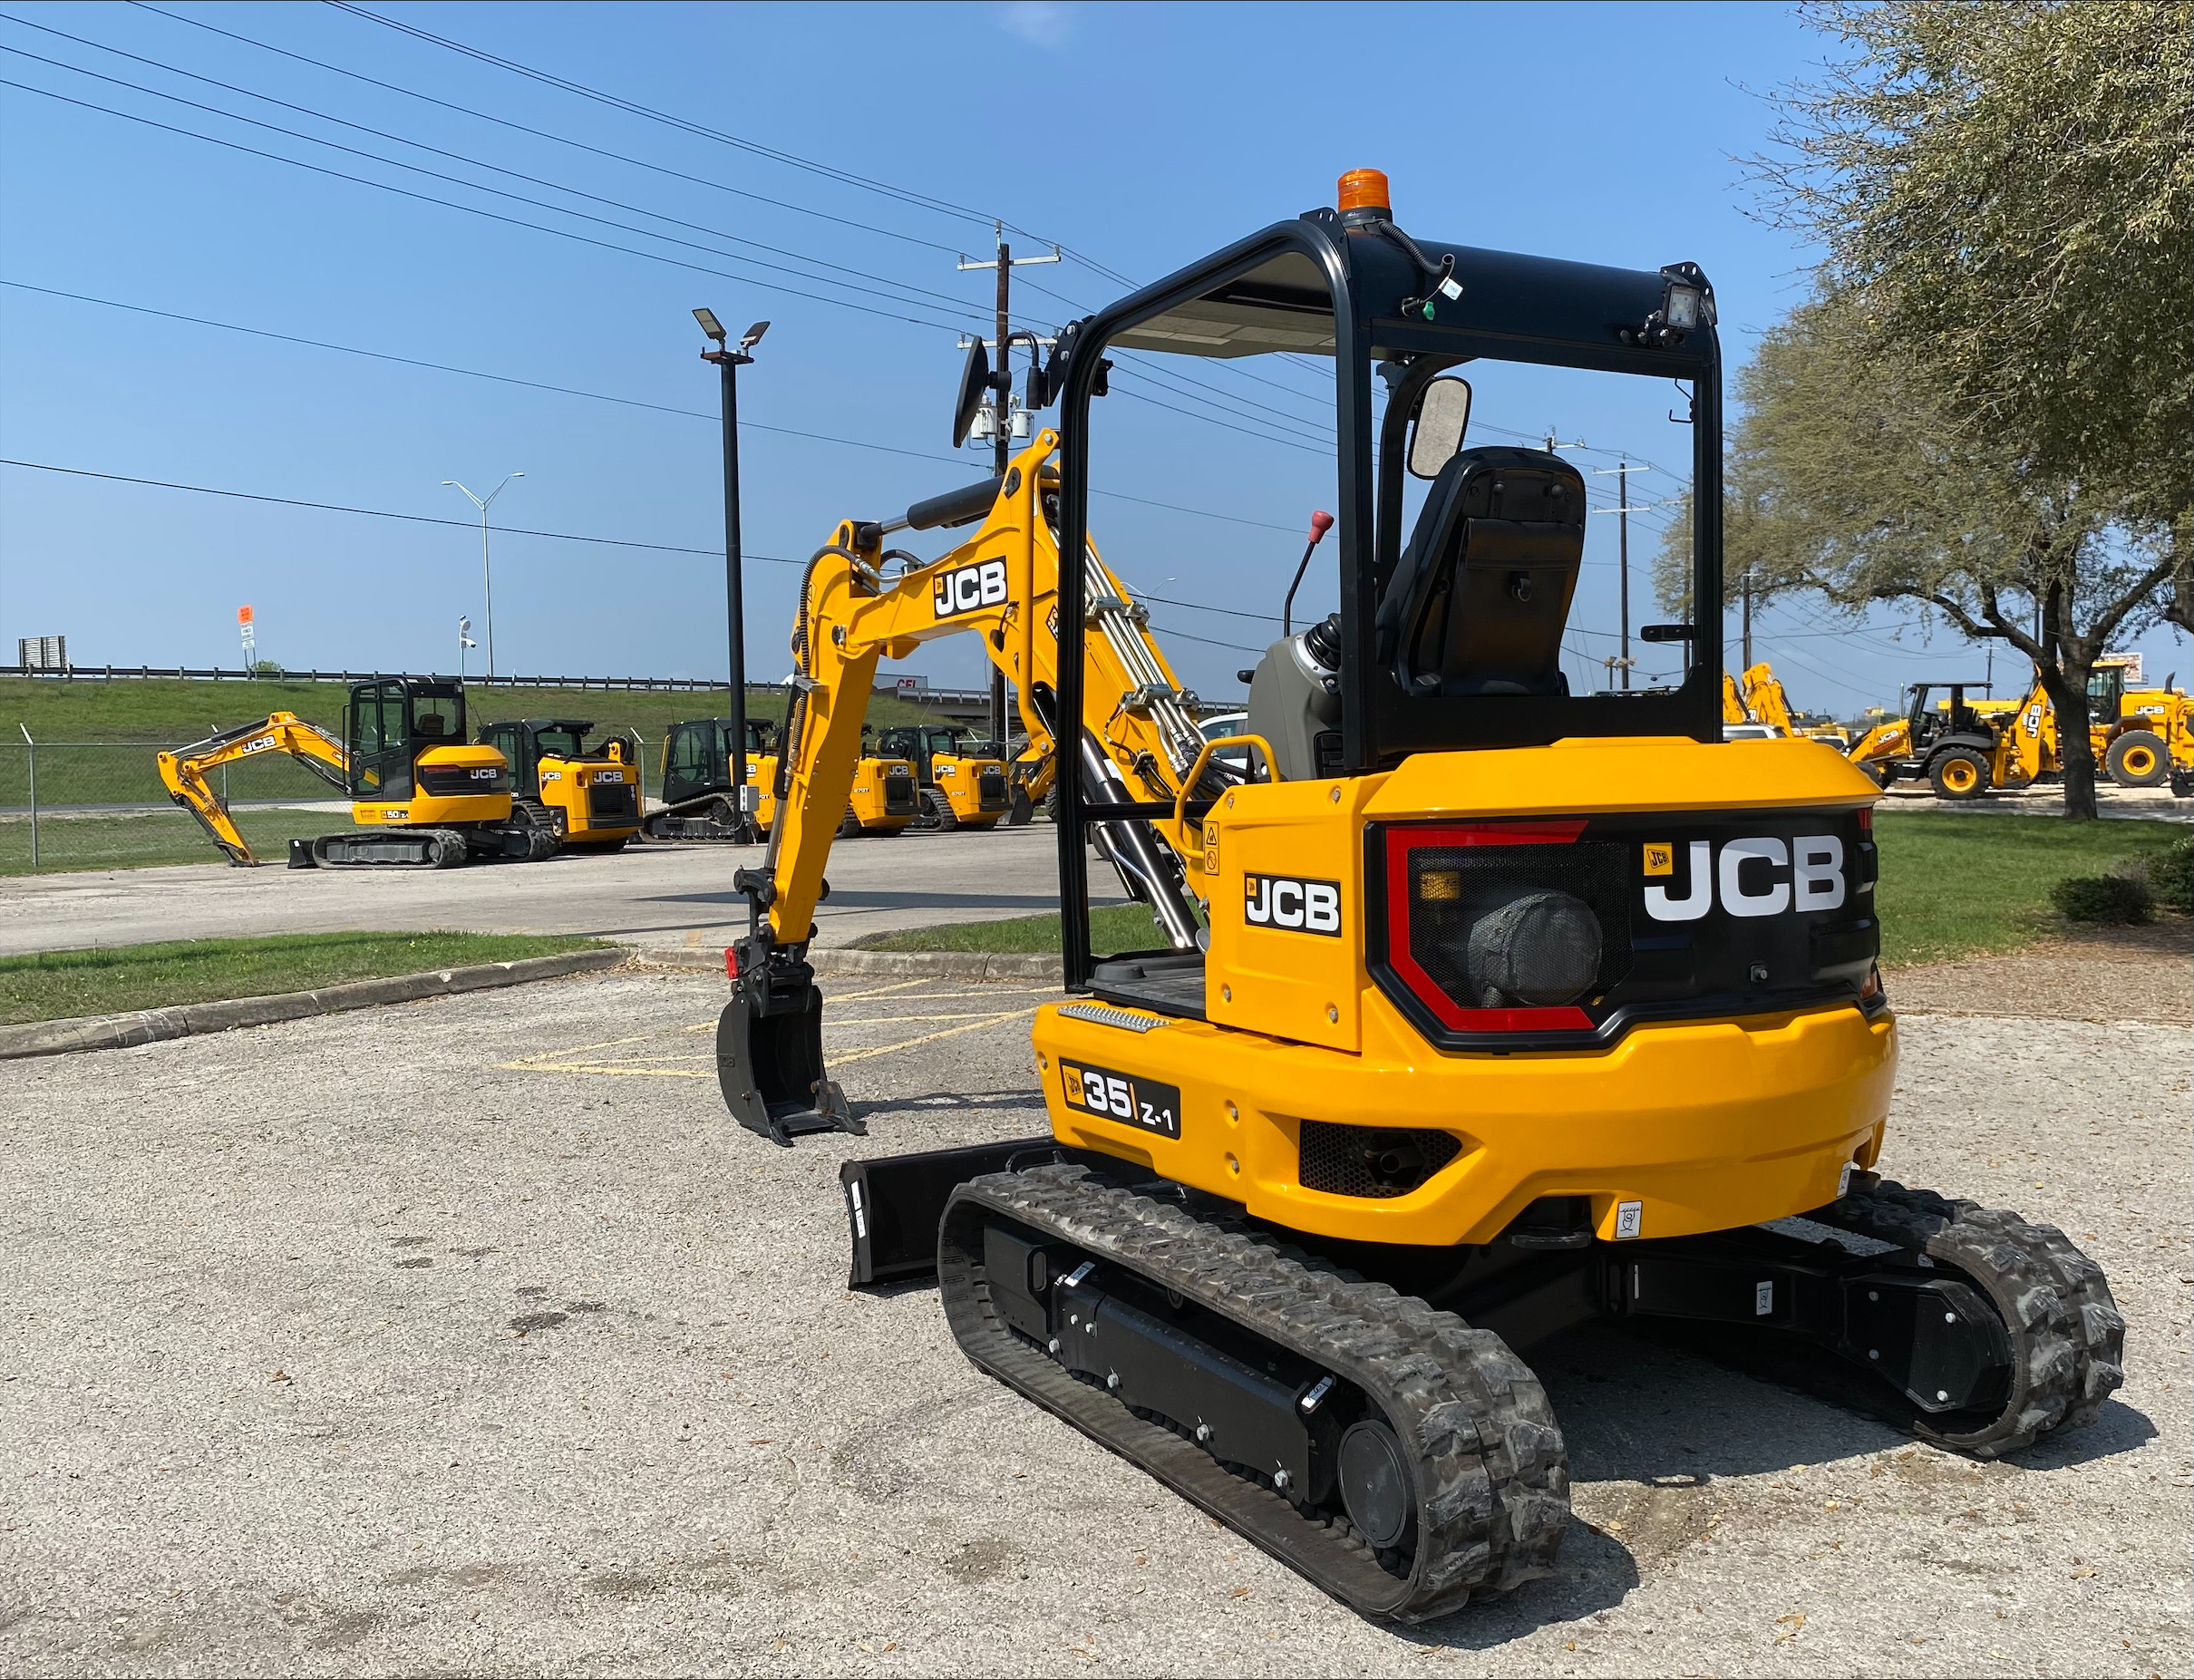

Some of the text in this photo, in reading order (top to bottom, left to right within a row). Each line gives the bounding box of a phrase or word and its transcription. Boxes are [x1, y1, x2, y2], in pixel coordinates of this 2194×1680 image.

[935, 561, 1007, 616] JCB
[2134, 705, 2165, 714] JCB
[2027, 704, 2042, 738] JCB
[1878, 729, 1899, 743] JCB
[242, 735, 276, 753] JCB
[470, 768, 498, 780] JCB
[541, 772, 561, 780] JCB
[888, 765, 908, 775] JCB
[935, 765, 956, 773] JCB
[983, 765, 1001, 774] JCB
[593, 771, 624, 782] JCB
[1649, 850, 1667, 867] JCB
[1644, 834, 1846, 922] JCB
[1246, 878, 1340, 932] JCB
[1083, 1071, 1132, 1118] 35
